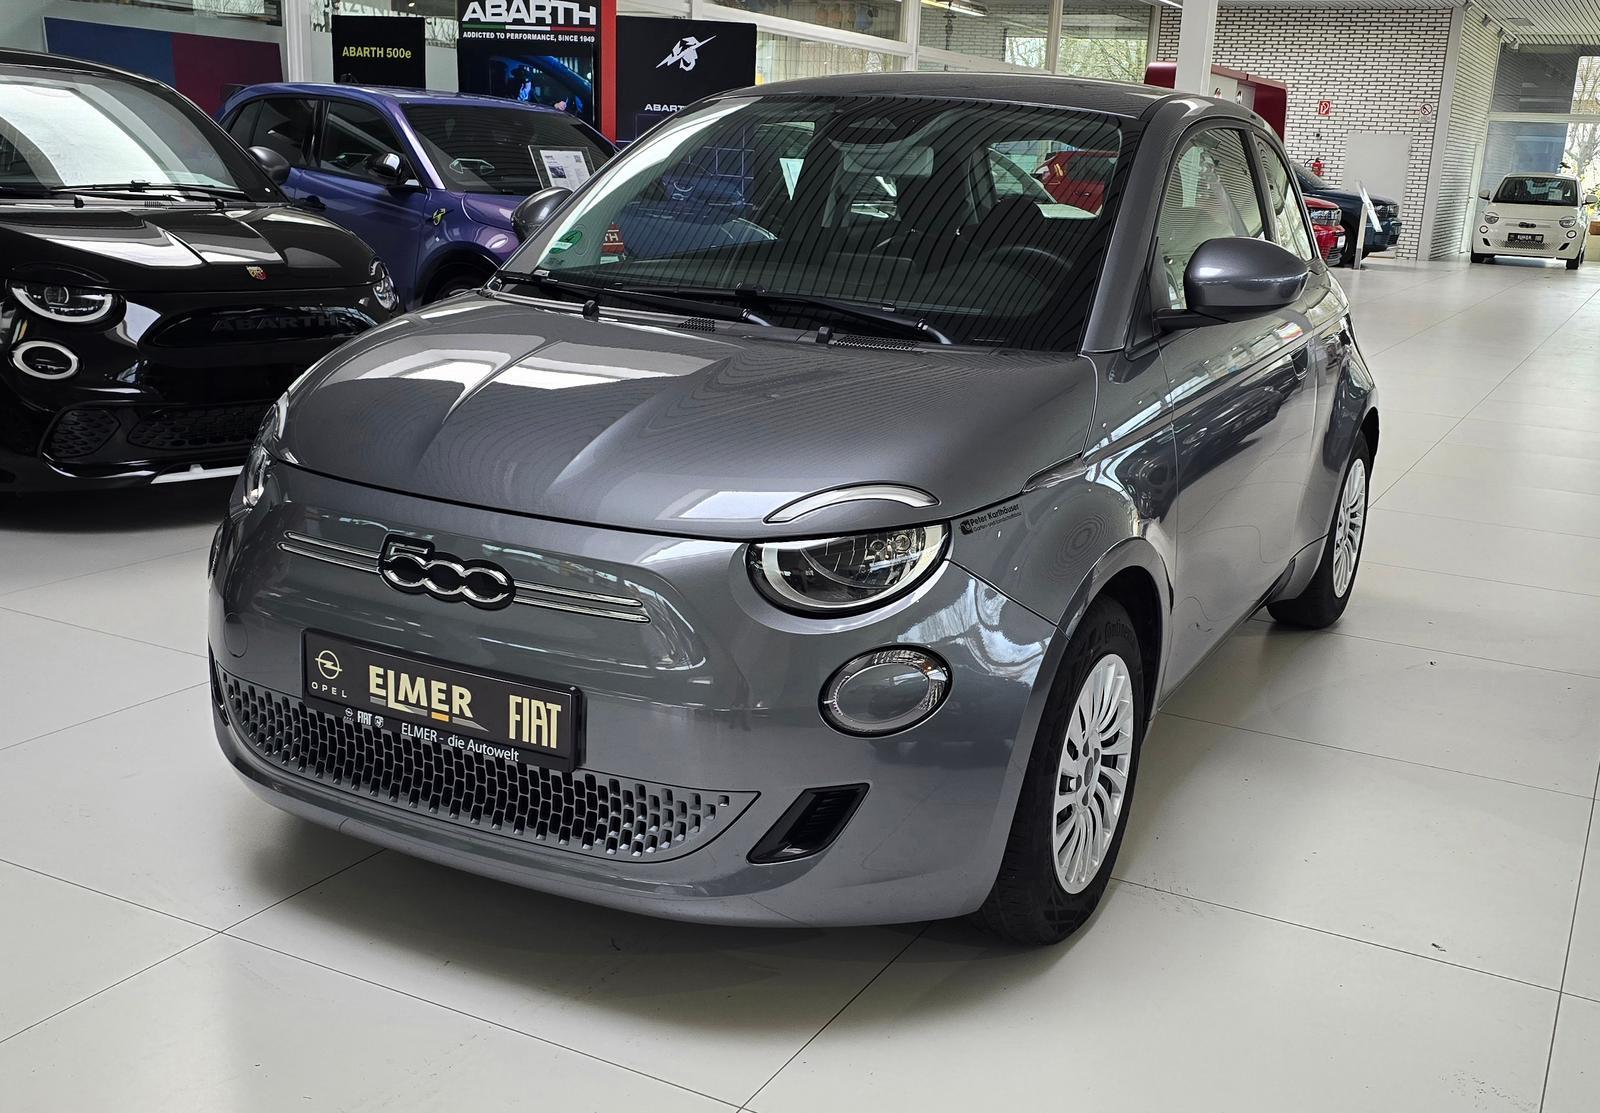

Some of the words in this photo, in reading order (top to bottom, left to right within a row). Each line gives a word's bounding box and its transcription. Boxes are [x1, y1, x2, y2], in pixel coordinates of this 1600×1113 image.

[462, 0, 597, 25] ABARTH
[462, 31, 495, 39] ADDICTED
[506, 33, 557, 42] PERFORMANCE,
[342, 46, 384, 58] ABARTH
[386, 47, 412, 59] 500e
[645, 104, 688, 112] ABART
[211, 315, 338, 332] ABARTH
[970, 514, 988, 526] Peter
[378, 532, 517, 611] 500
[311, 681, 348, 698] OPEL
[369, 665, 473, 718] ELMER
[357, 710, 373, 726] FIAT
[508, 695, 562, 750] FIAT
[401, 722, 438, 743] ELMER
[447, 734, 465, 749] die
[466, 738, 520, 762] Autowelt
